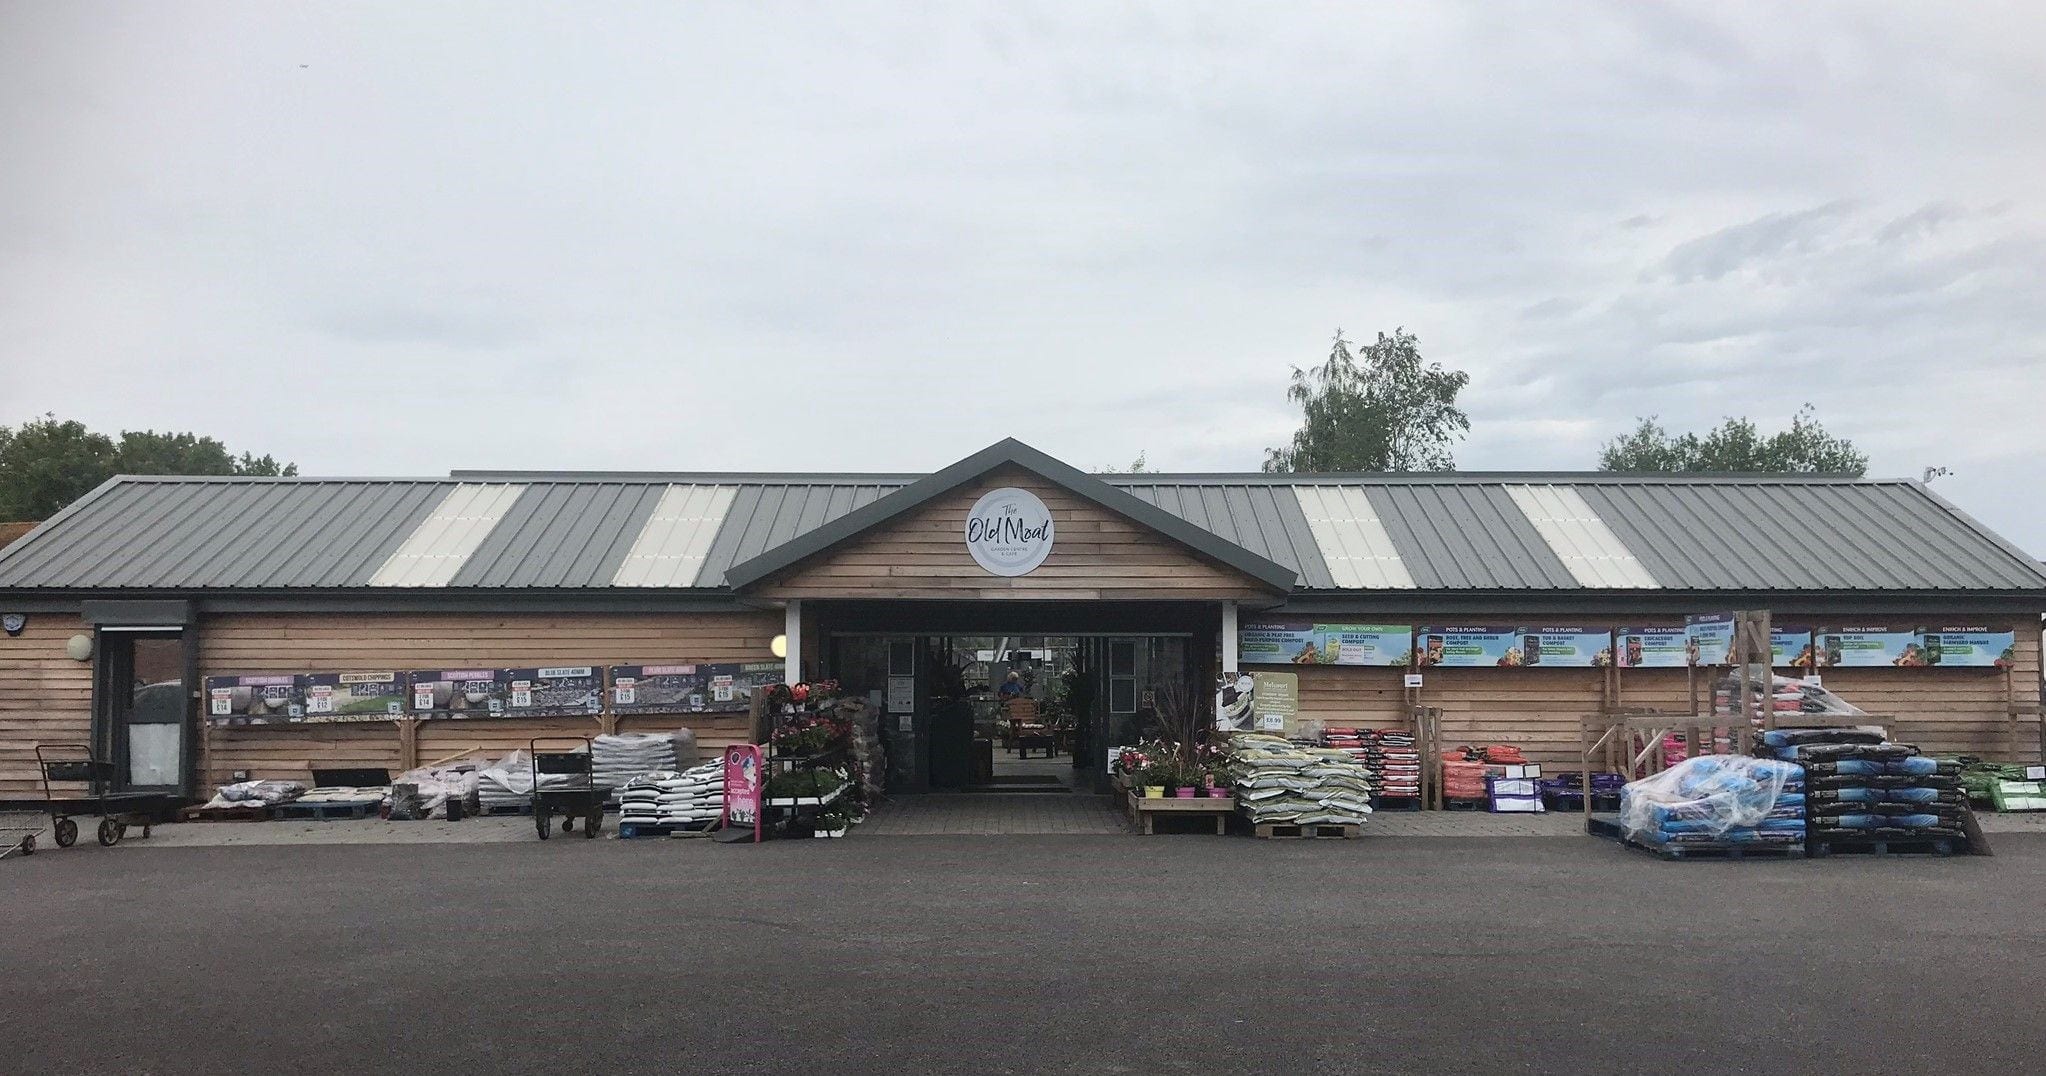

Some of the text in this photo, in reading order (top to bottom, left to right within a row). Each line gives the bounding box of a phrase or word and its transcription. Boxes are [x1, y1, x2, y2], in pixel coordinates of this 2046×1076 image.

[1002, 502, 1018, 516] The
[968, 517, 1050, 544] Old Moat
[419, 698, 429, 706] £14
[738, 796, 754, 808] here
